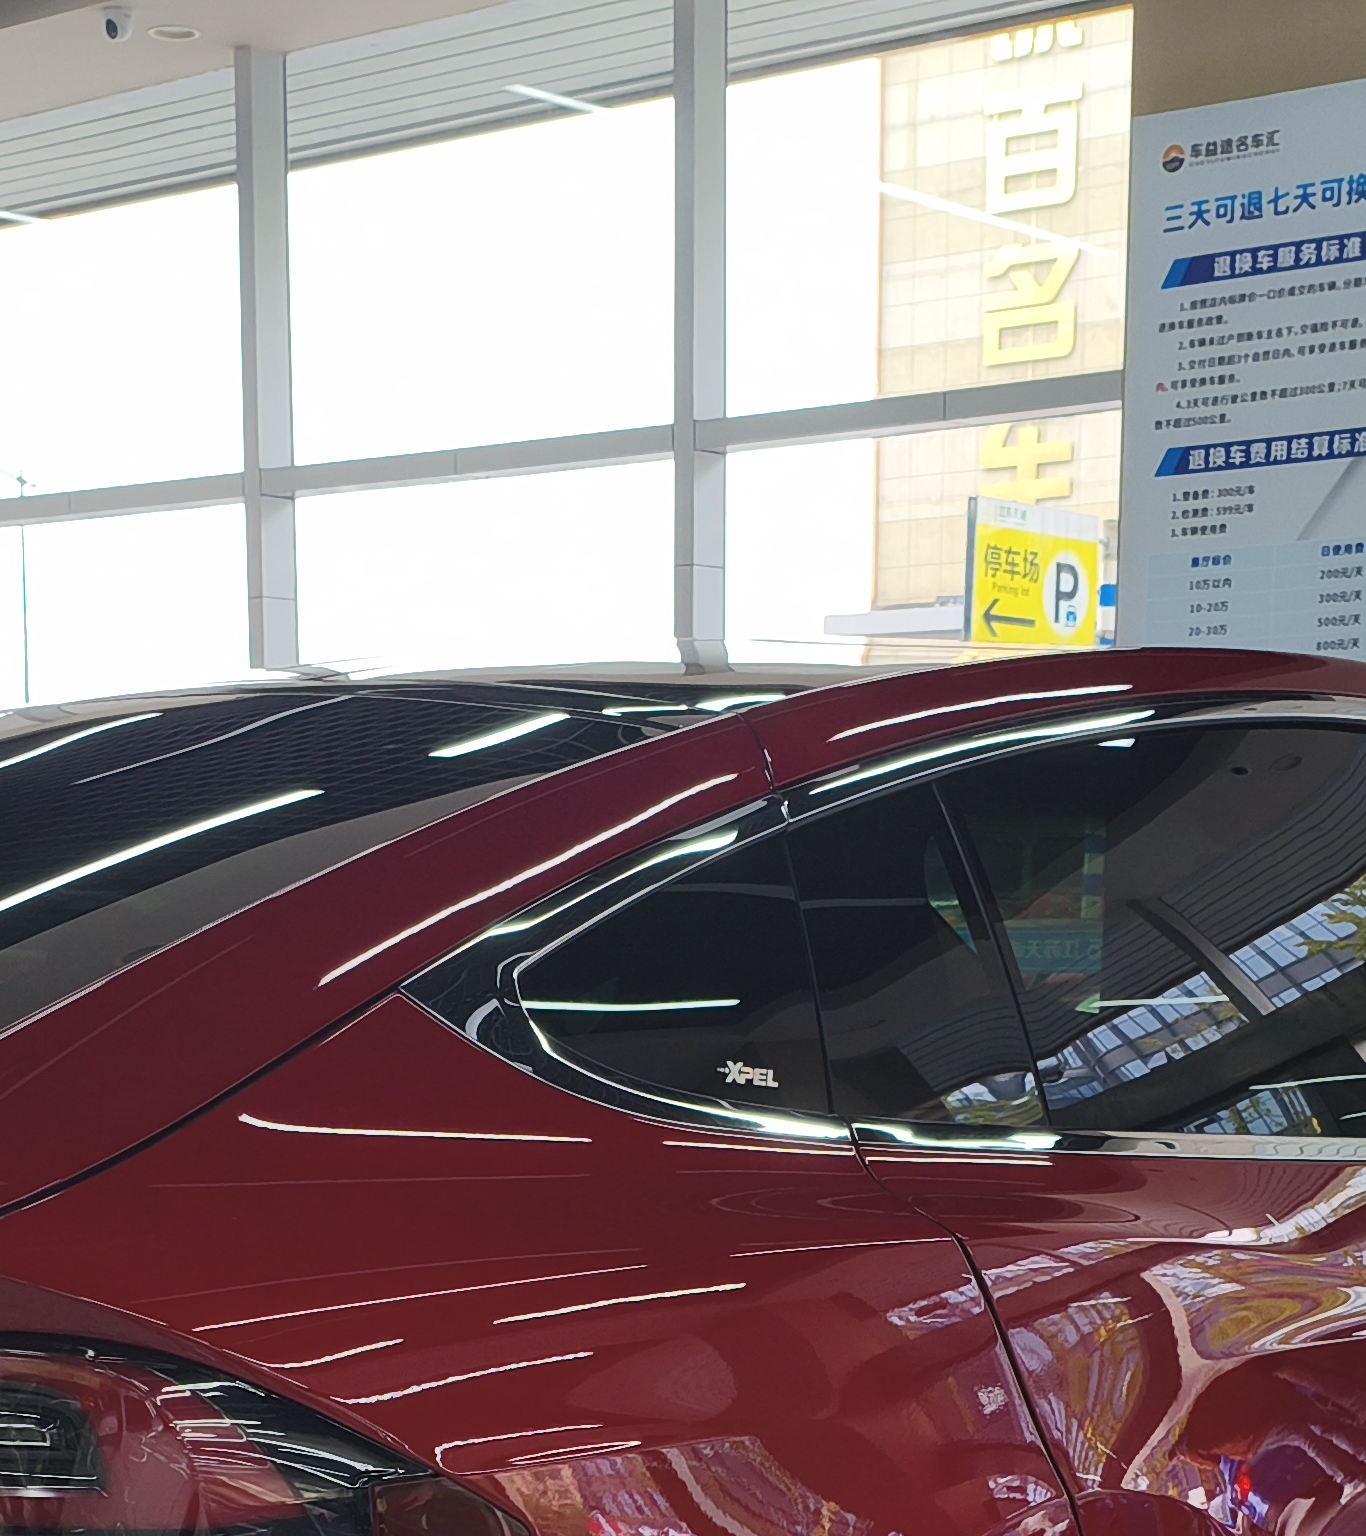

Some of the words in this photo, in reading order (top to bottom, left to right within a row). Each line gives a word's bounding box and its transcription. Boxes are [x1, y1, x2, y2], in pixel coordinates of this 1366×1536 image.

[1214, 237, 1362, 276] 退换车服务标准
[984, 544, 1040, 584] 停车场
[1054, 561, 1079, 623] P
[725, 1060, 779, 1088] XPEL
